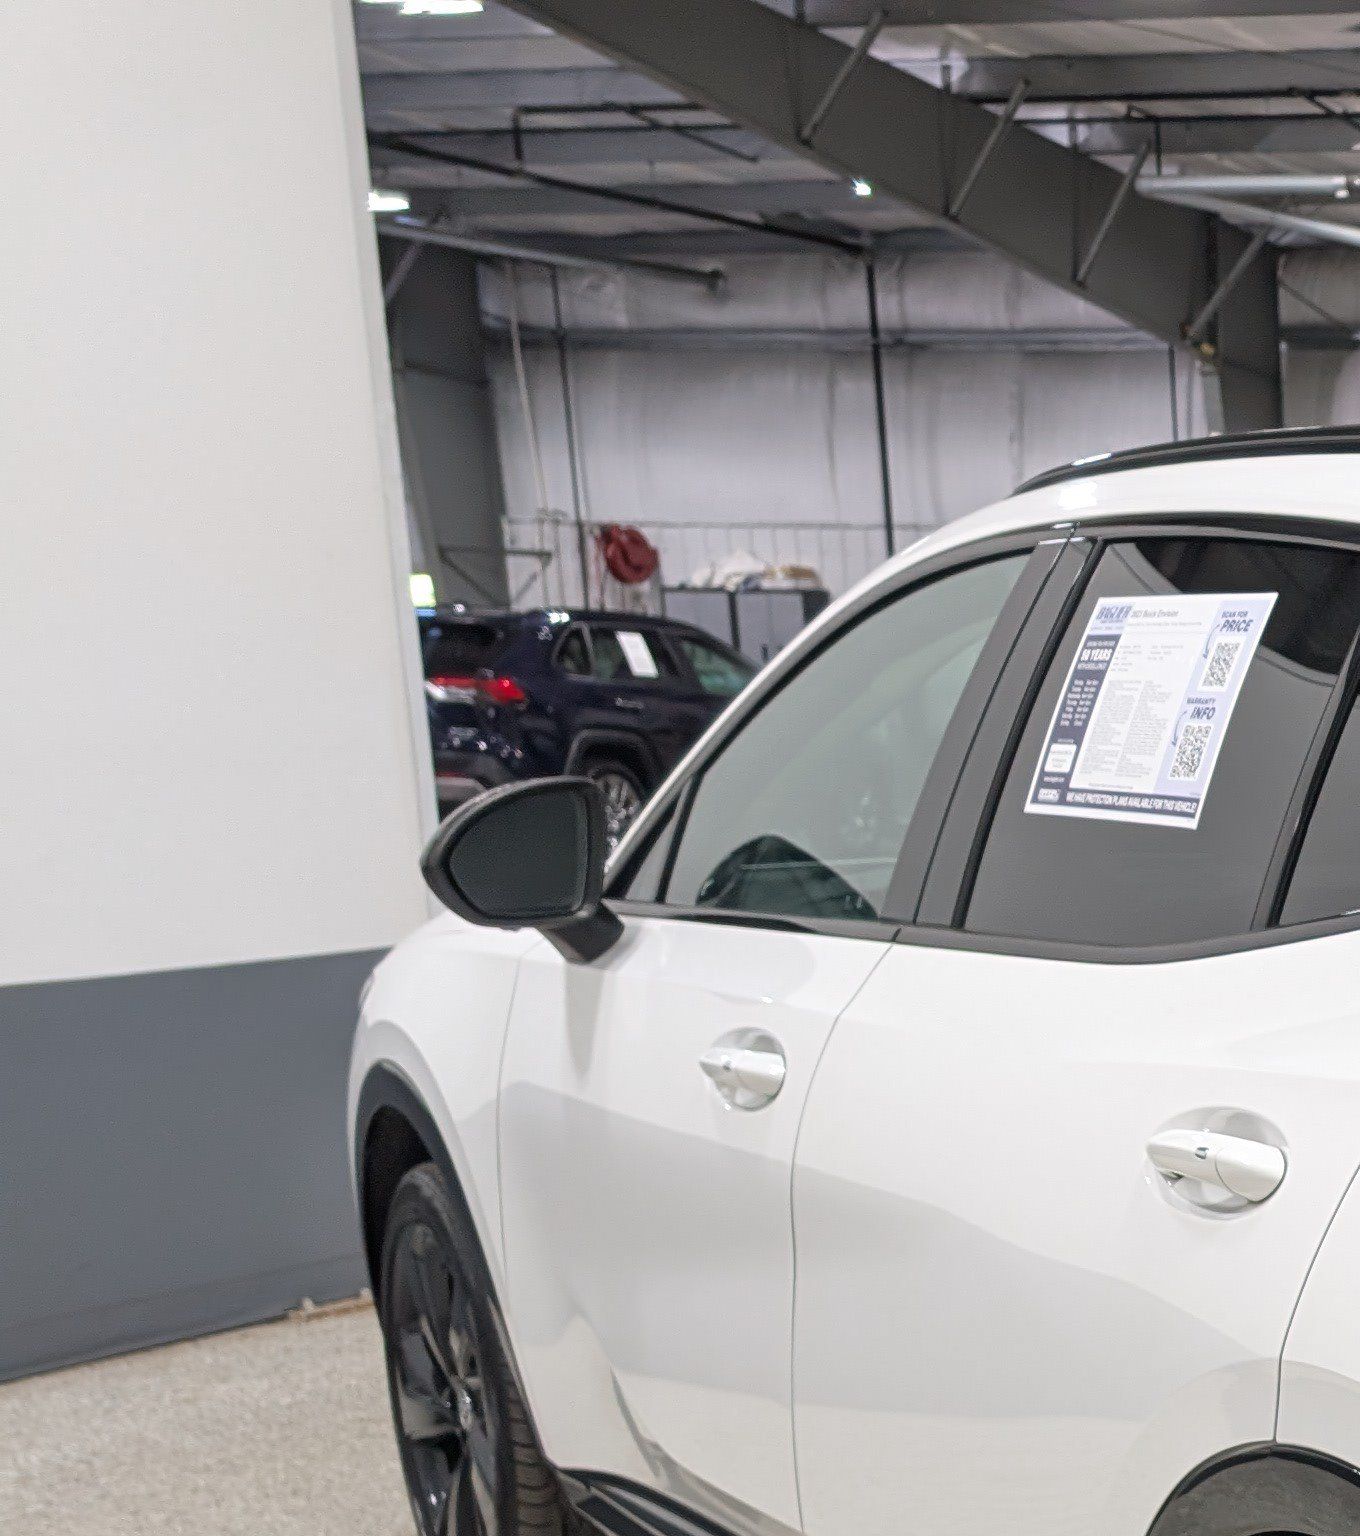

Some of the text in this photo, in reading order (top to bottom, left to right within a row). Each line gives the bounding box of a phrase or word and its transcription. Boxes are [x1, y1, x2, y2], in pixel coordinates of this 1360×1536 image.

[1237, 610, 1248, 618] FOR
[1220, 619, 1254, 632] PRICE
[1190, 706, 1216, 720] INFO
